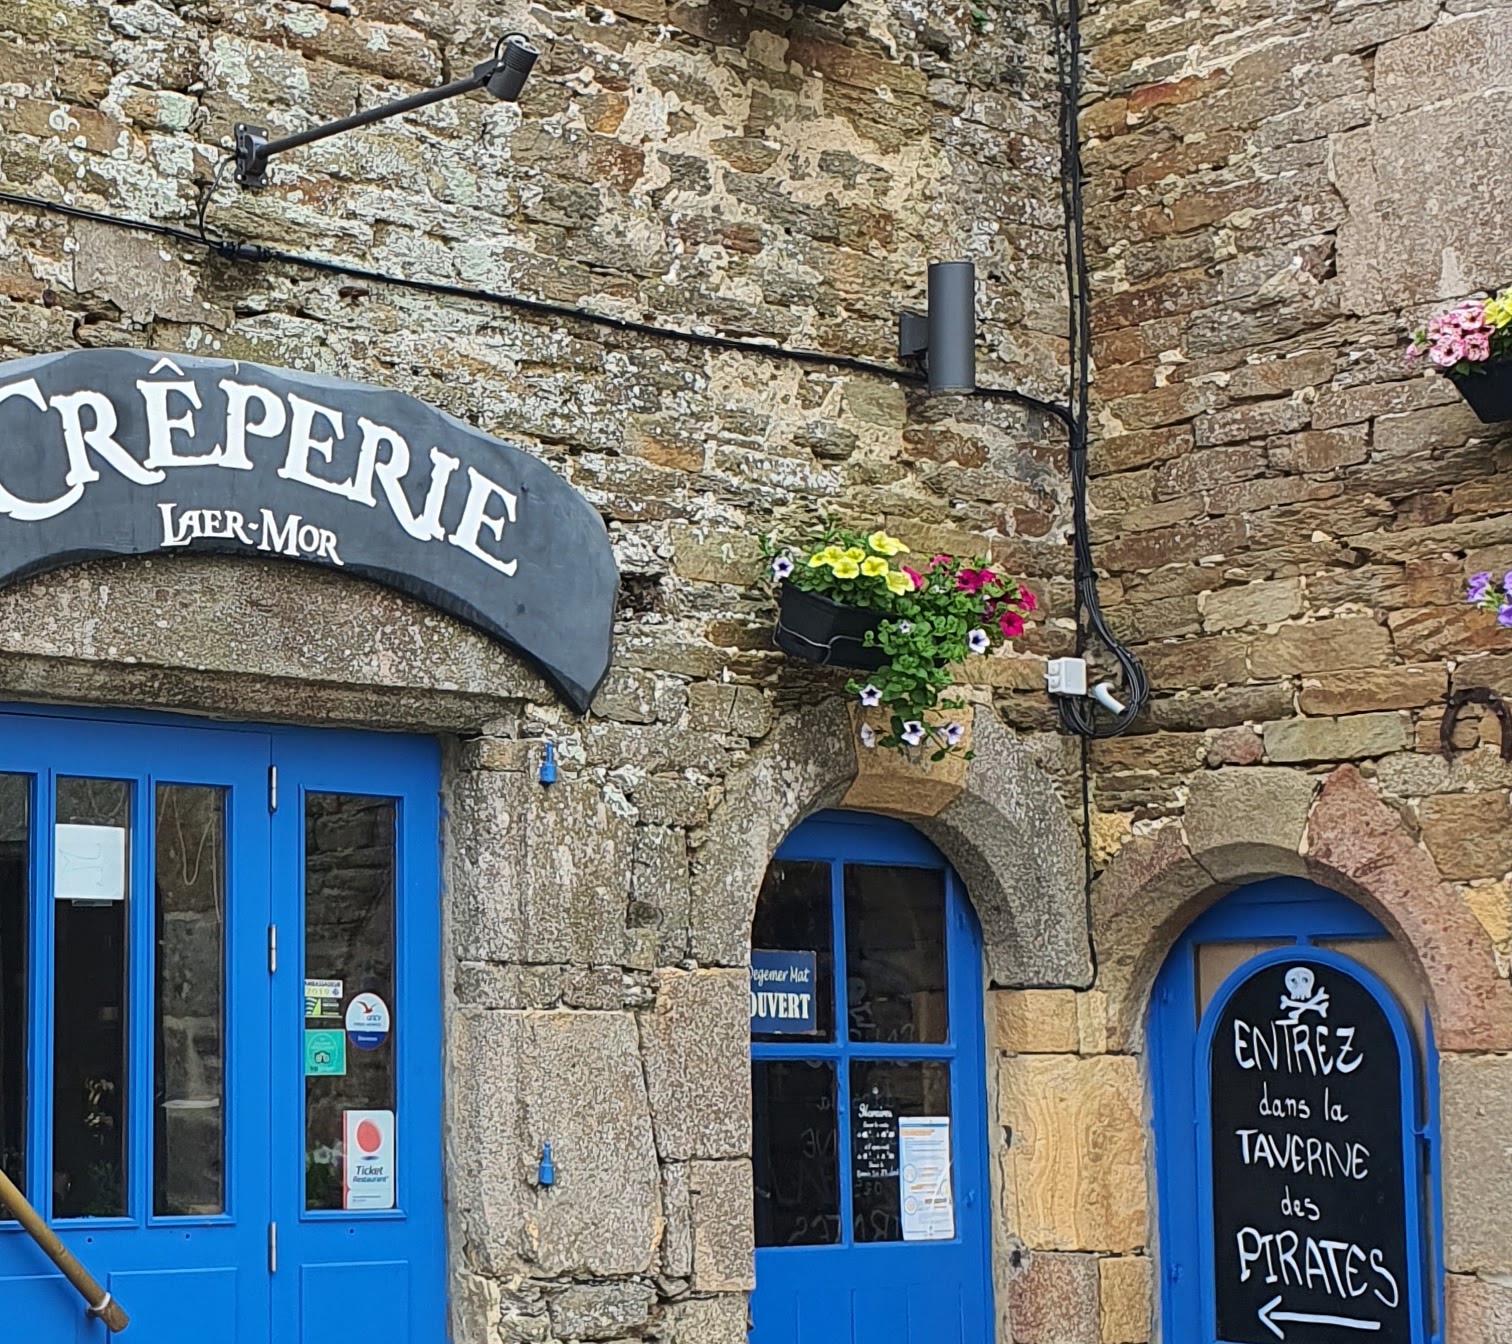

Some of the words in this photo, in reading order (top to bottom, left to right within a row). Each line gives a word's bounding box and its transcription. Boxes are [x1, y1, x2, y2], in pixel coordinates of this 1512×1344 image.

[157, 503, 344, 566] LAER-MOR
[790, 965, 810, 983] Mat
[1234, 1011, 1363, 1076] ENTREZ
[1259, 1082, 1311, 1118] dans
[1324, 1087, 1349, 1122] la
[356, 1166, 383, 1175] Ticket
[1236, 1129, 1370, 1179] TAVERNE
[1281, 1185, 1320, 1221] des
[1236, 1226, 1399, 1307] PIRATES
